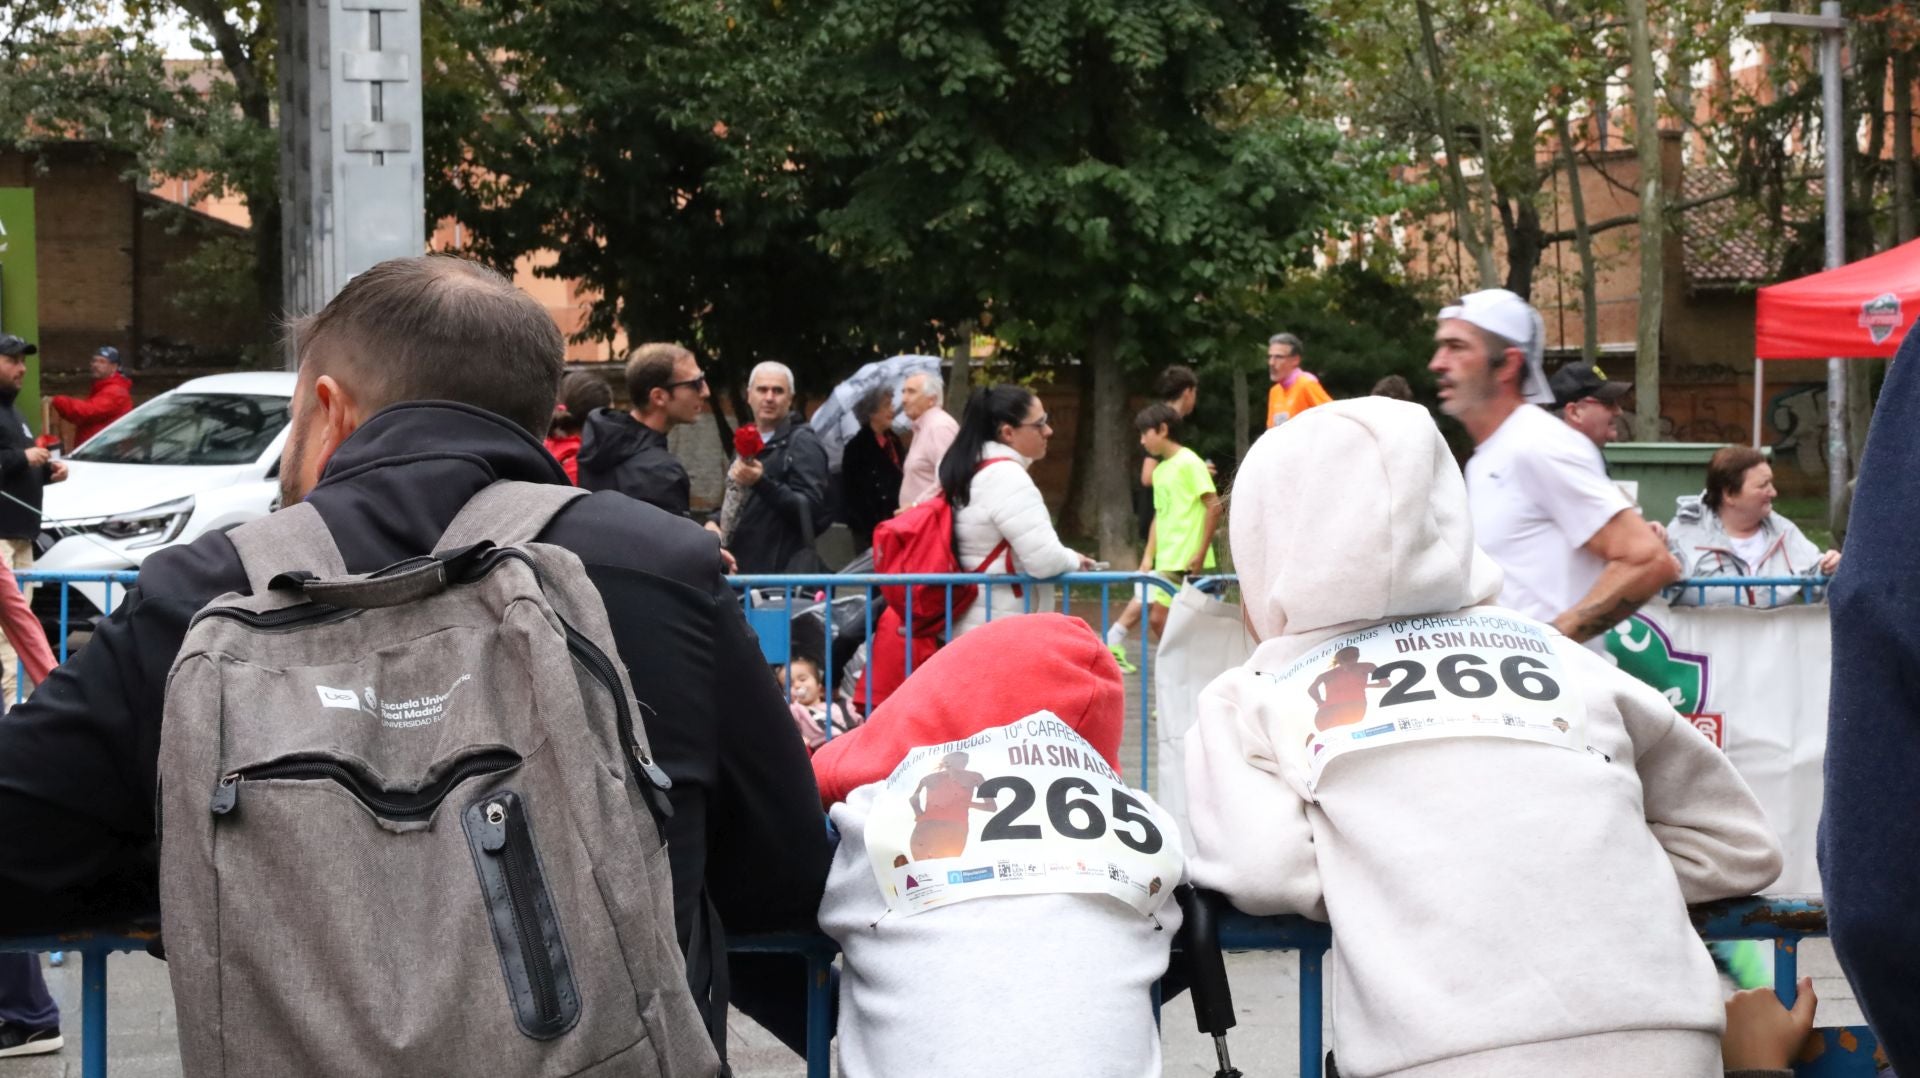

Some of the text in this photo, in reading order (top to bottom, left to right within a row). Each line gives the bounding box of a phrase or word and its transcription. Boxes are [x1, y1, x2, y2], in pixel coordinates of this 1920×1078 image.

[1411, 616, 1479, 631] CARRERA
[1306, 654, 1319, 665] no
[1321, 647, 1332, 657] te
[1334, 642, 1344, 652] lo
[1346, 629, 1379, 647] bebas
[1395, 632, 1555, 655] DÍA SIN ALCOHOL
[1371, 653, 1561, 708] 266
[380, 698, 420, 712] Escuela
[381, 708, 403, 720] Real
[404, 704, 443, 720] Madrid
[381, 717, 432, 729] UNIVERSIDAD
[1007, 738, 1045, 766] DÍA
[1046, 744, 1080, 769] SIN
[976, 775, 1163, 855] 265
